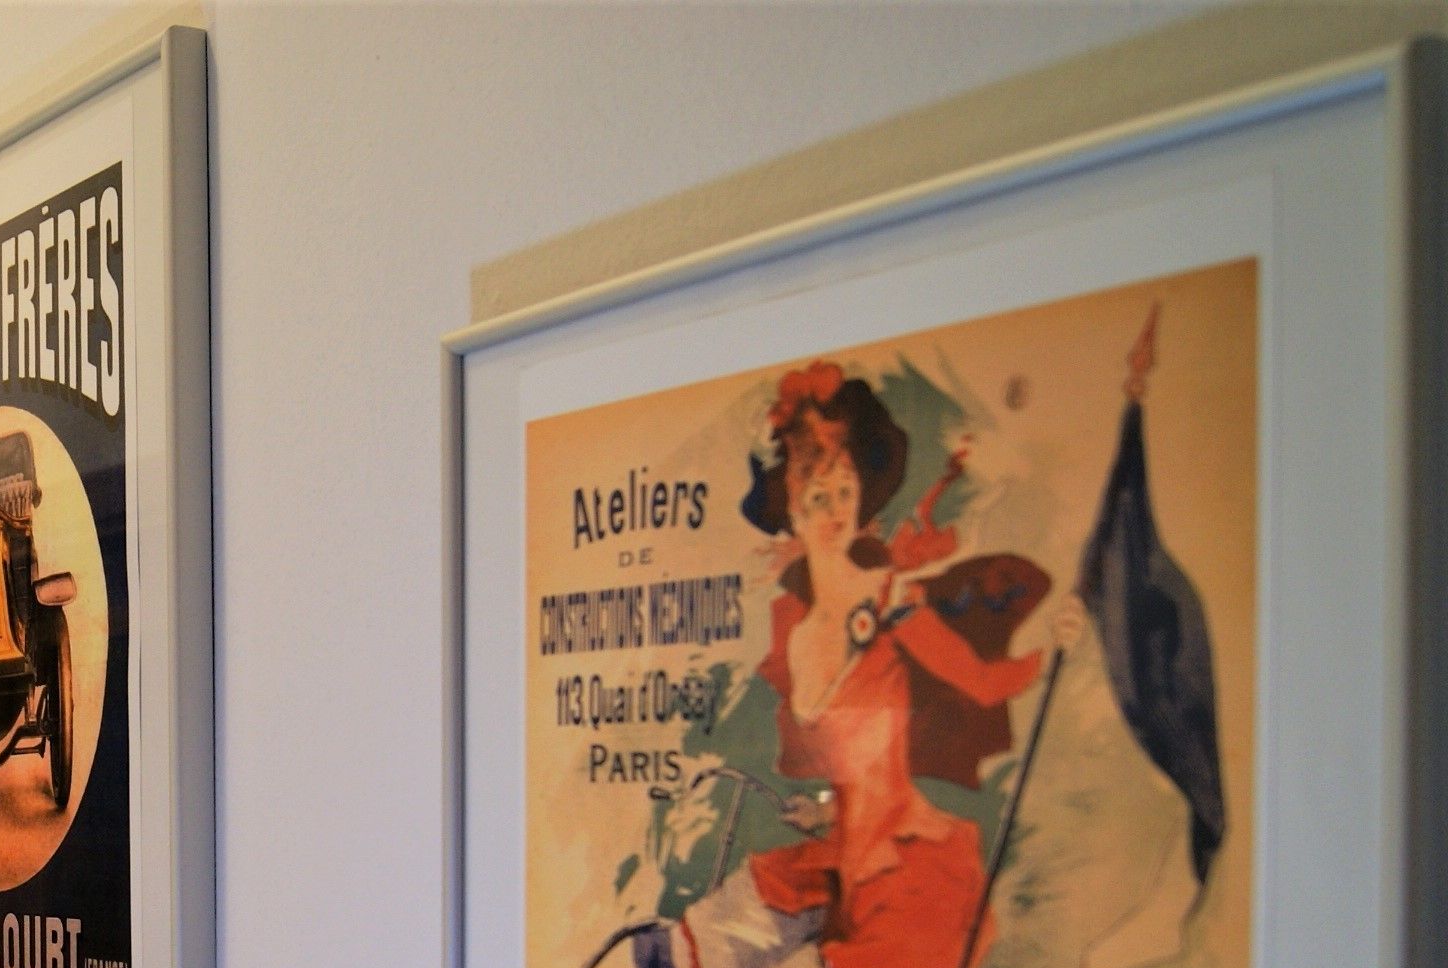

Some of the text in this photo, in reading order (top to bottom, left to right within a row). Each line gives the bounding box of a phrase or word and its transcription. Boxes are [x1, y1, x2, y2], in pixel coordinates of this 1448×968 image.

[573, 466, 708, 549] Ateliers
[618, 548, 654, 568] DE
[589, 743, 681, 783] PARIS
